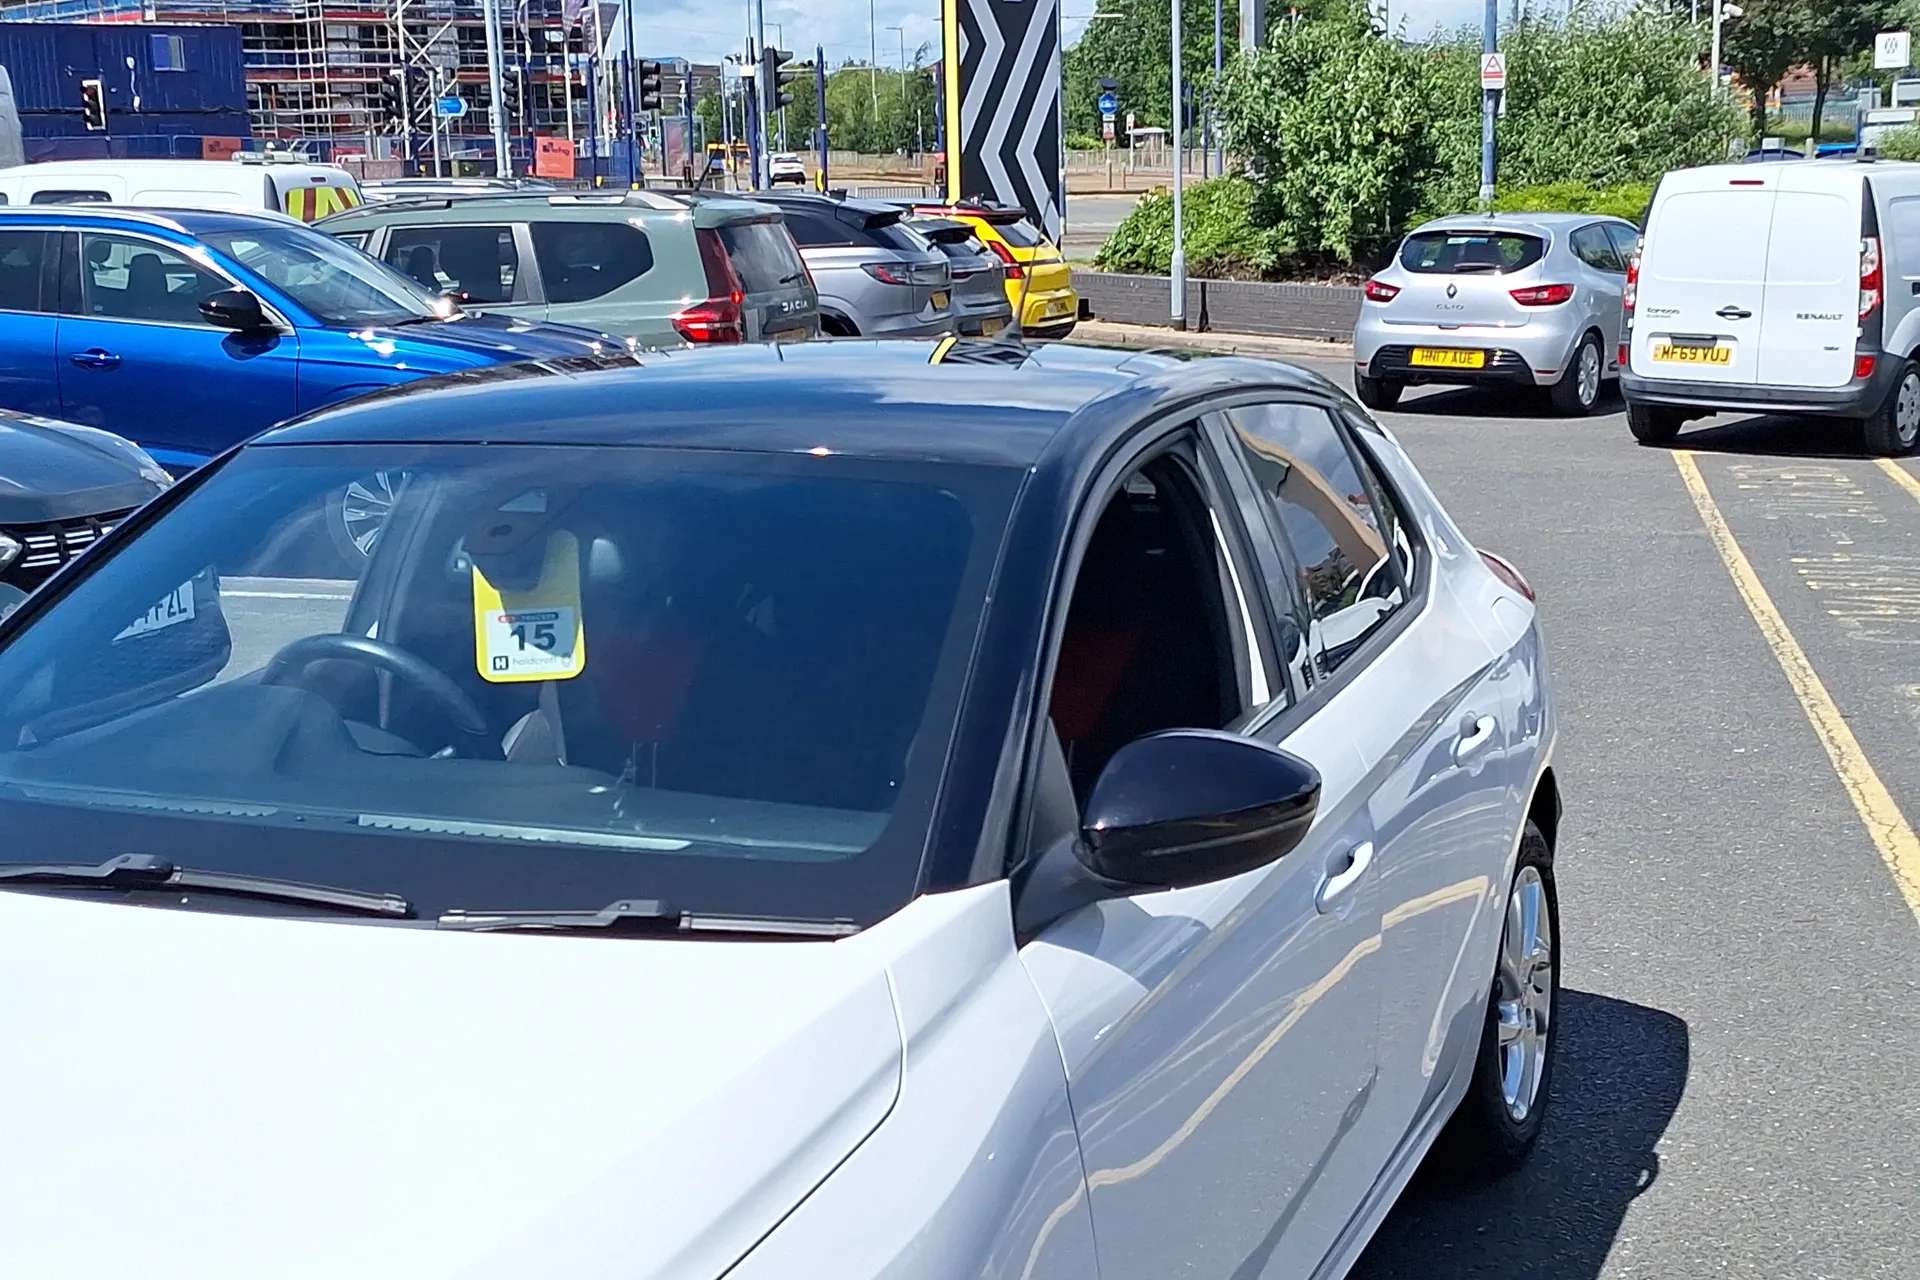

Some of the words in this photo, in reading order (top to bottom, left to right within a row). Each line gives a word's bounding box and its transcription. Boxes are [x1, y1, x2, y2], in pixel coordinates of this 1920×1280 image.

[781, 300, 809, 312] DACIA
[1796, 312, 1844, 321] RENAULT
[1661, 345, 1697, 361] MF69
[1702, 347, 1730, 362] VUJ
[510, 623, 556, 651] 15
